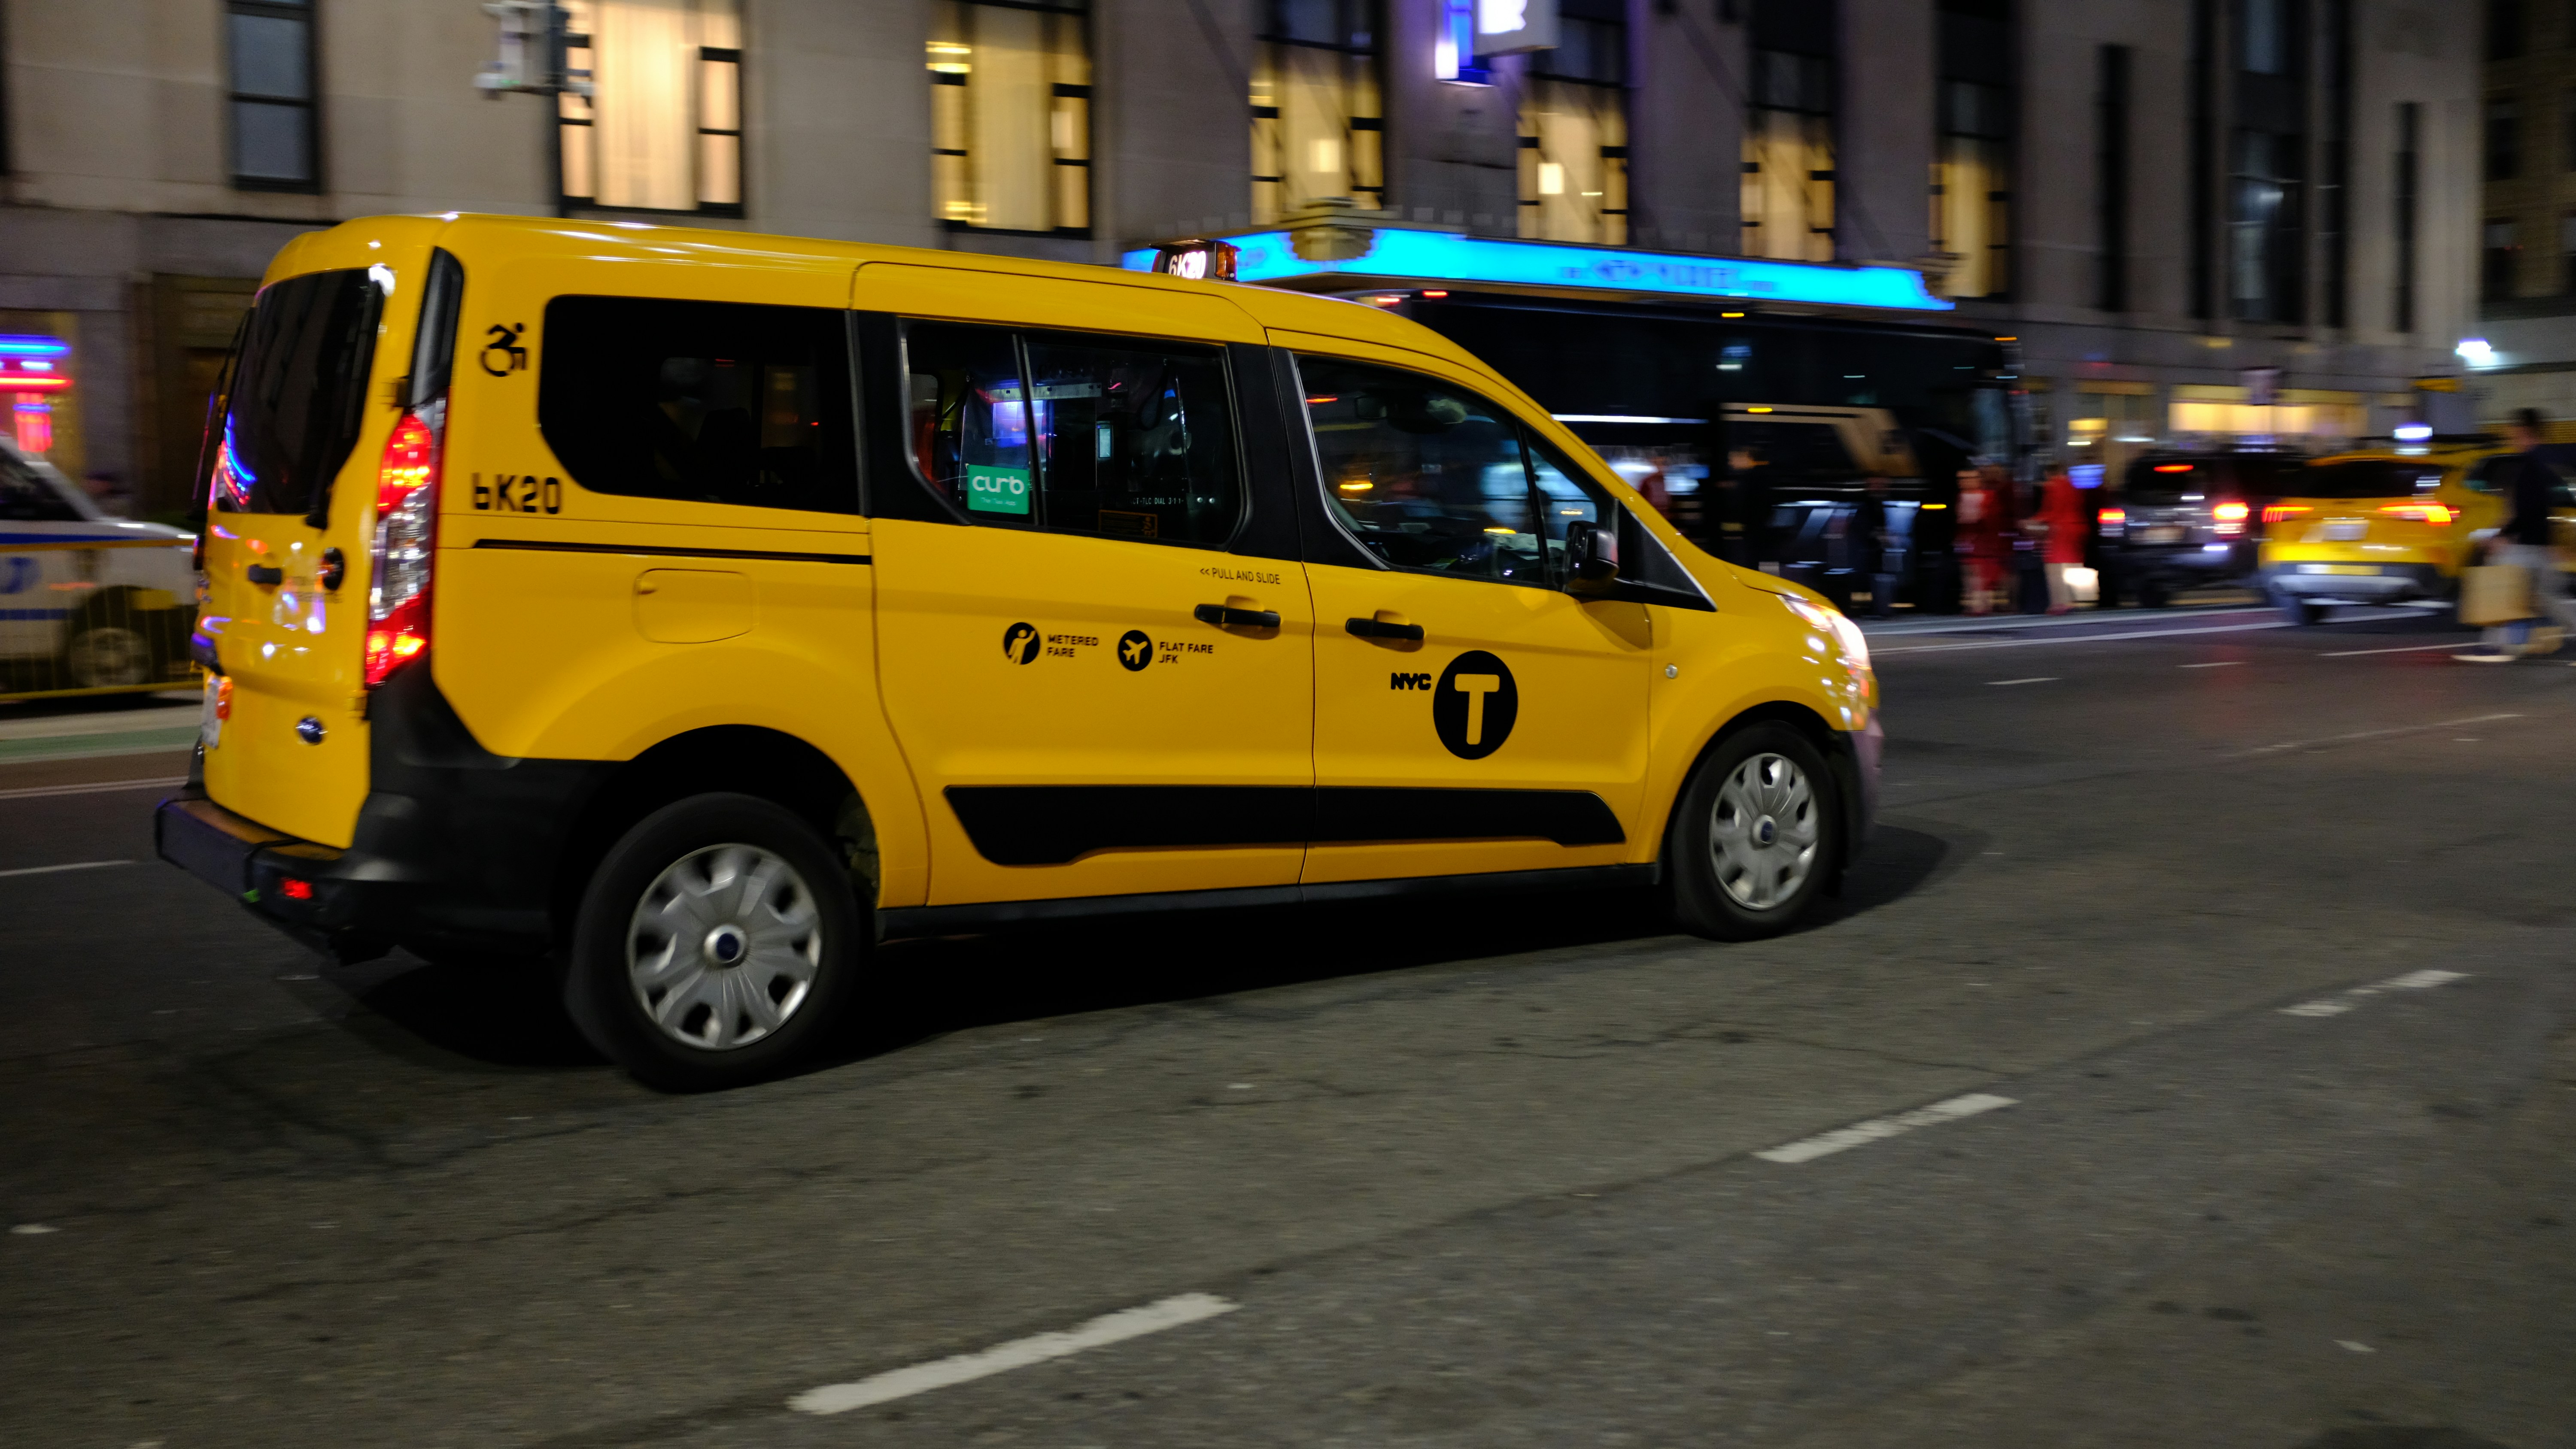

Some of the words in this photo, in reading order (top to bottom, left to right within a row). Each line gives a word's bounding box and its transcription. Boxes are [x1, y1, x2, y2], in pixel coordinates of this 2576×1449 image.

[1168, 251, 1206, 279] 6K20
[972, 476, 1025, 495] curb
[1212, 567, 1234, 580] PULL
[1236, 570, 1254, 582] AND
[1256, 572, 1281, 585] SLIDE
[1047, 634, 1099, 647] METERED
[1160, 641, 1184, 652] FLAT
[1187, 643, 1214, 654] FARE
[1047, 647, 1075, 658] FARE
[1159, 654, 1178, 664] JFK
[1391, 673, 1431, 690] NYC
[1454, 673, 1501, 746] T
